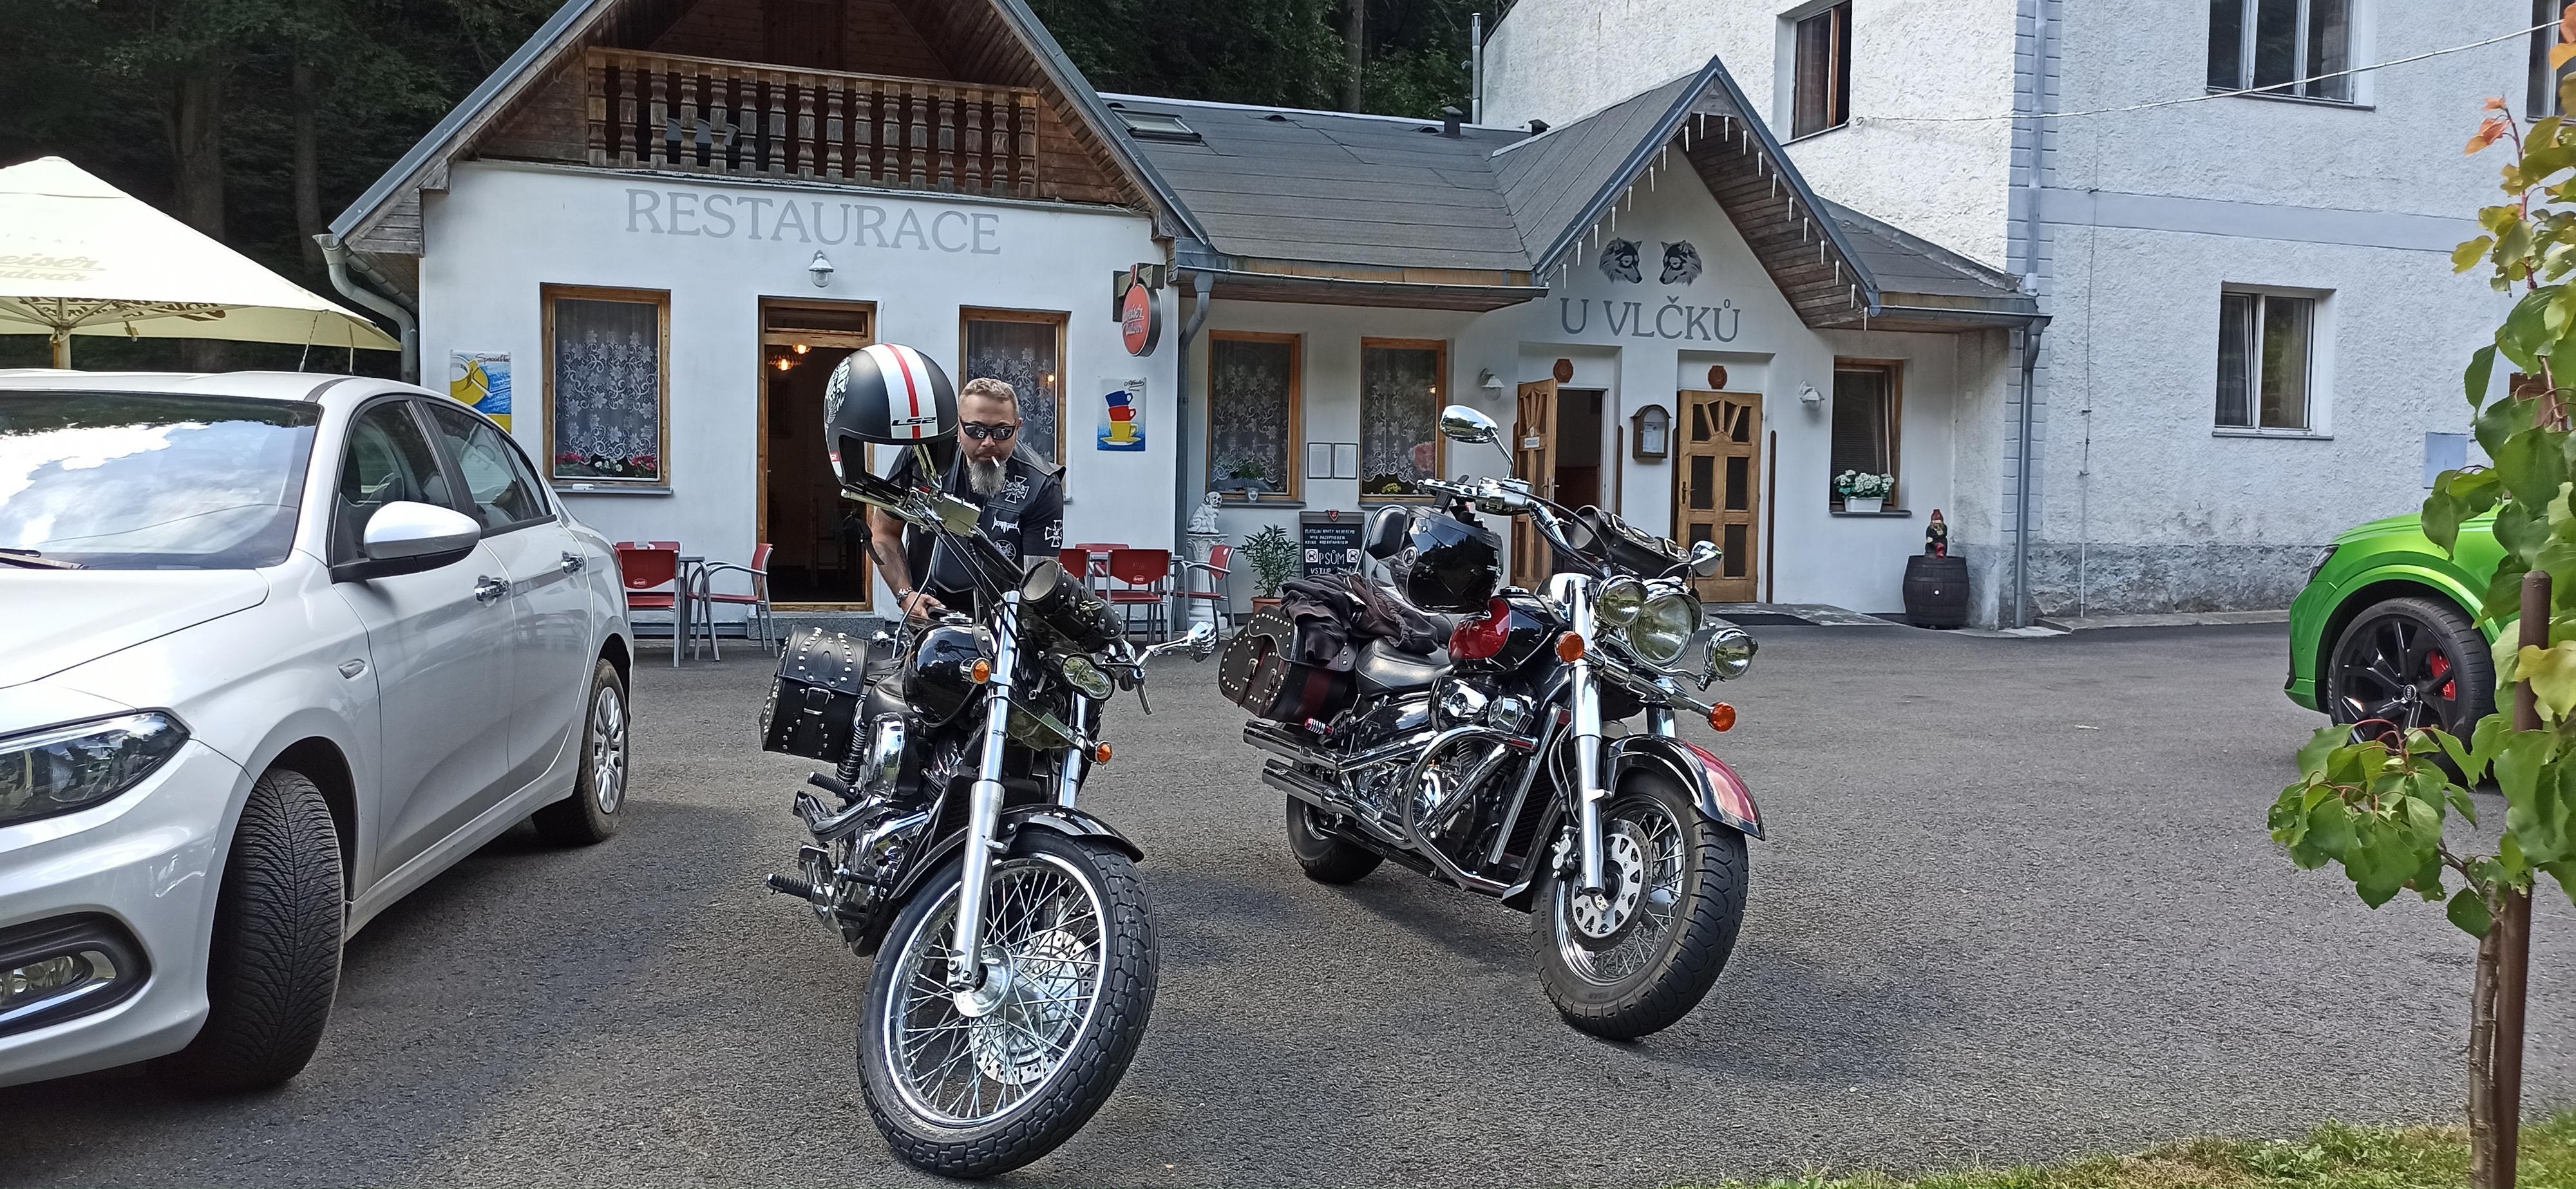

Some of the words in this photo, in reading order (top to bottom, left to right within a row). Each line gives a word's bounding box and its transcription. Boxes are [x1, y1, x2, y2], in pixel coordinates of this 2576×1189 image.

[625, 188, 1001, 255] RESTAURACE
[1560, 297, 1589, 335] U
[1603, 295, 1741, 342] VLČKŮ
[891, 417, 936, 426] LS2
[1318, 549, 1345, 565] PSŮM
